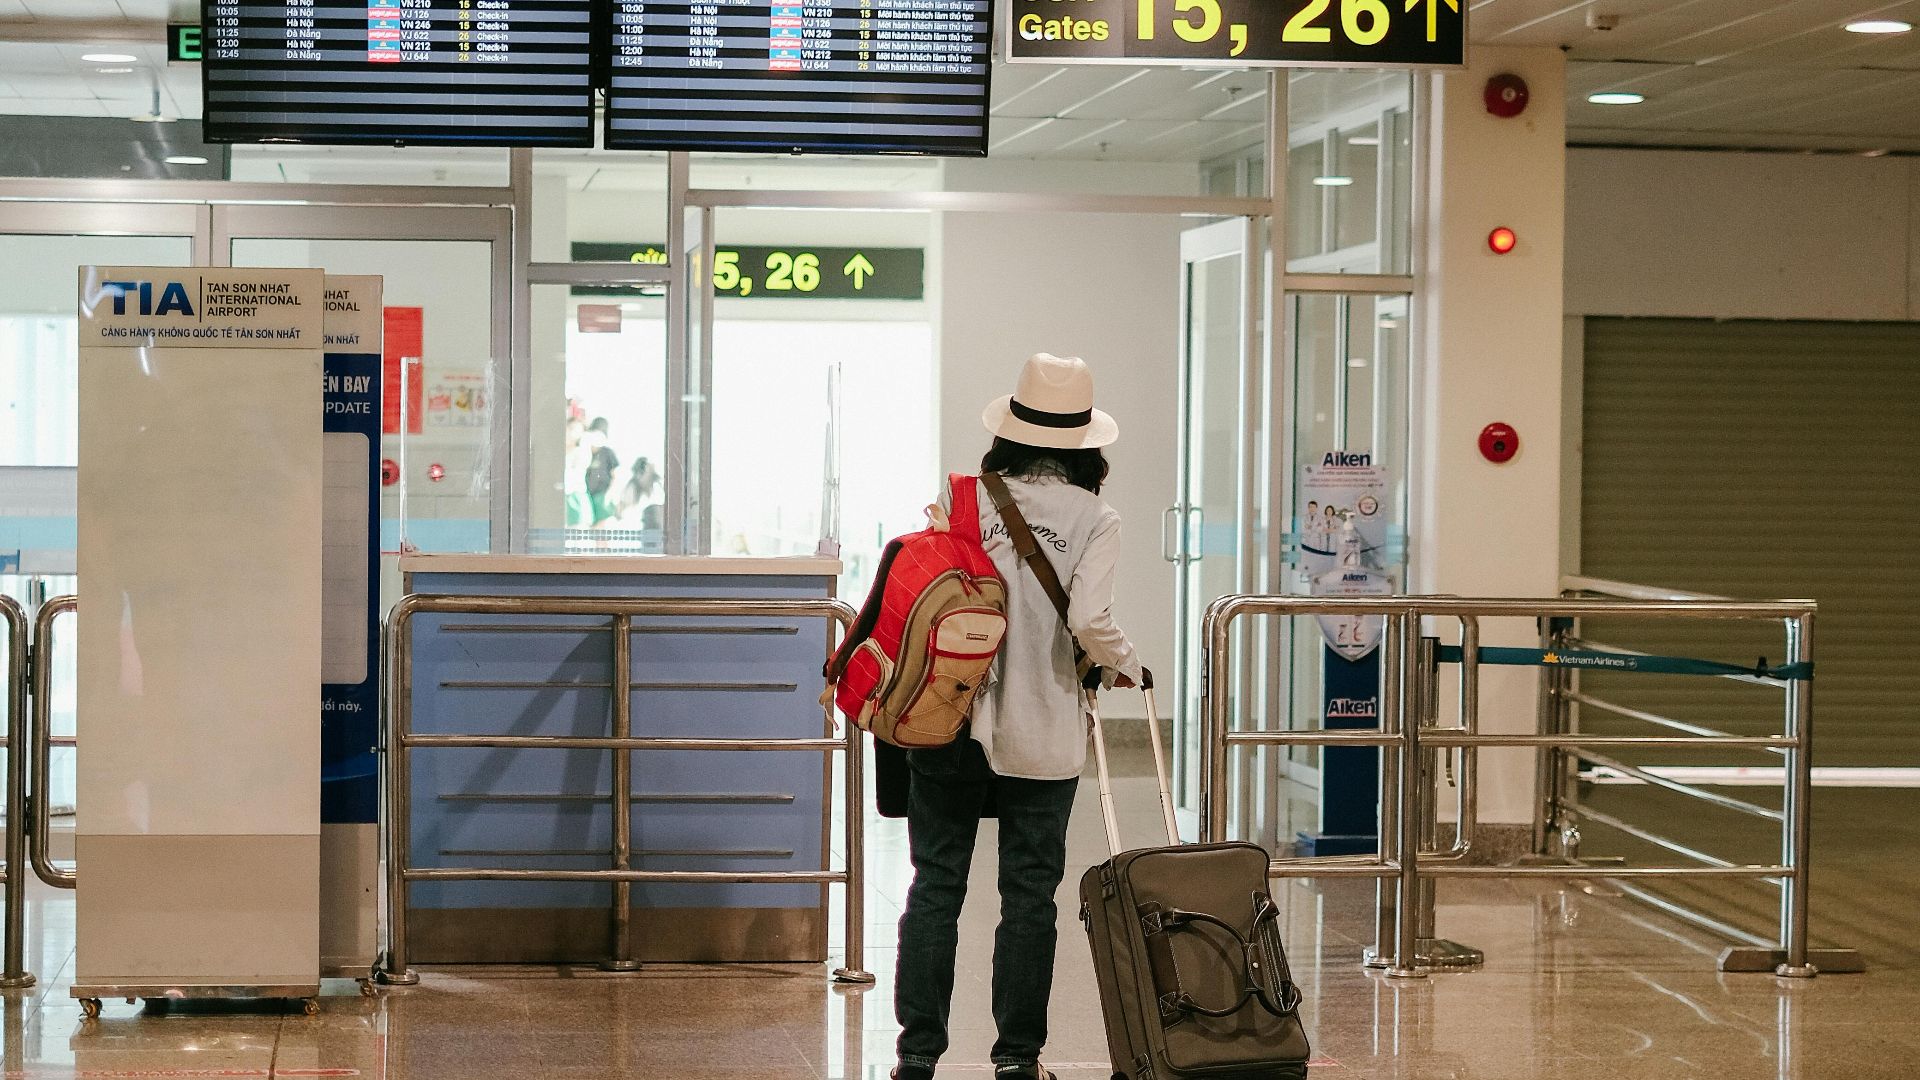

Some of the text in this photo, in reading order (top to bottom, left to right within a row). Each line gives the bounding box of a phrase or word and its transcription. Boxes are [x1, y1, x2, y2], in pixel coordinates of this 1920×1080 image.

[401, 10, 412, 18] VJ
[414, 10, 429, 18] 126
[459, 11, 469, 19] 26
[621, 4, 644, 12] 10:00
[803, 8, 816, 16] VN
[817, 8, 832, 17] 210
[860, 10, 870, 18] 15
[401, 21, 414, 29] VN
[414, 21, 431, 29] 246
[621, 15, 643, 23] 10:05
[860, 20, 870, 28] 26
[1019, 14, 1109, 40] Gates
[621, 25, 643, 34] 11:00
[803, 30, 816, 38] VN
[816, 30, 831, 38] 246
[860, 31, 870, 39] 15
[1137, 0, 1391, 57] 15, 26
[401, 31, 412, 39] VJ
[414, 31, 429, 39] 622
[459, 32, 469, 40] 26
[401, 42, 414, 50] VN
[414, 42, 431, 50] 212
[620, 36, 642, 44] 11:25
[859, 41, 869, 50] 26
[401, 52, 412, 60] VJ
[414, 52, 429, 60] 644
[620, 46, 642, 55] 12:00
[802, 50, 815, 59] VN
[816, 51, 831, 59] 212
[859, 52, 869, 60] 15
[620, 57, 642, 65] 12:45
[858, 62, 868, 70] 26
[765, 252, 820, 292] 26
[207, 282, 290, 293] TAN SON NHAT
[102, 282, 194, 316] TIA
[206, 295, 302, 305] INTERNATIONAL
[207, 307, 257, 316] AIRPORT
[102, 325, 127, 337] CẢNG
[130, 326, 155, 338] HÀNG
[158, 327, 190, 338] KHÔNG
[193, 326, 219, 338] QUỐC
[221, 326, 233, 338] TẾ
[235, 327, 253, 339] TÂN
[276, 327, 301, 339] NHẤT
[344, 376, 370, 392] BAY
[326, 402, 371, 414] PDATE
[1323, 452, 1371, 466] Aiken
[1559, 656, 1625, 666] Vietnam Airlines
[1329, 701, 1375, 714] Aiken
